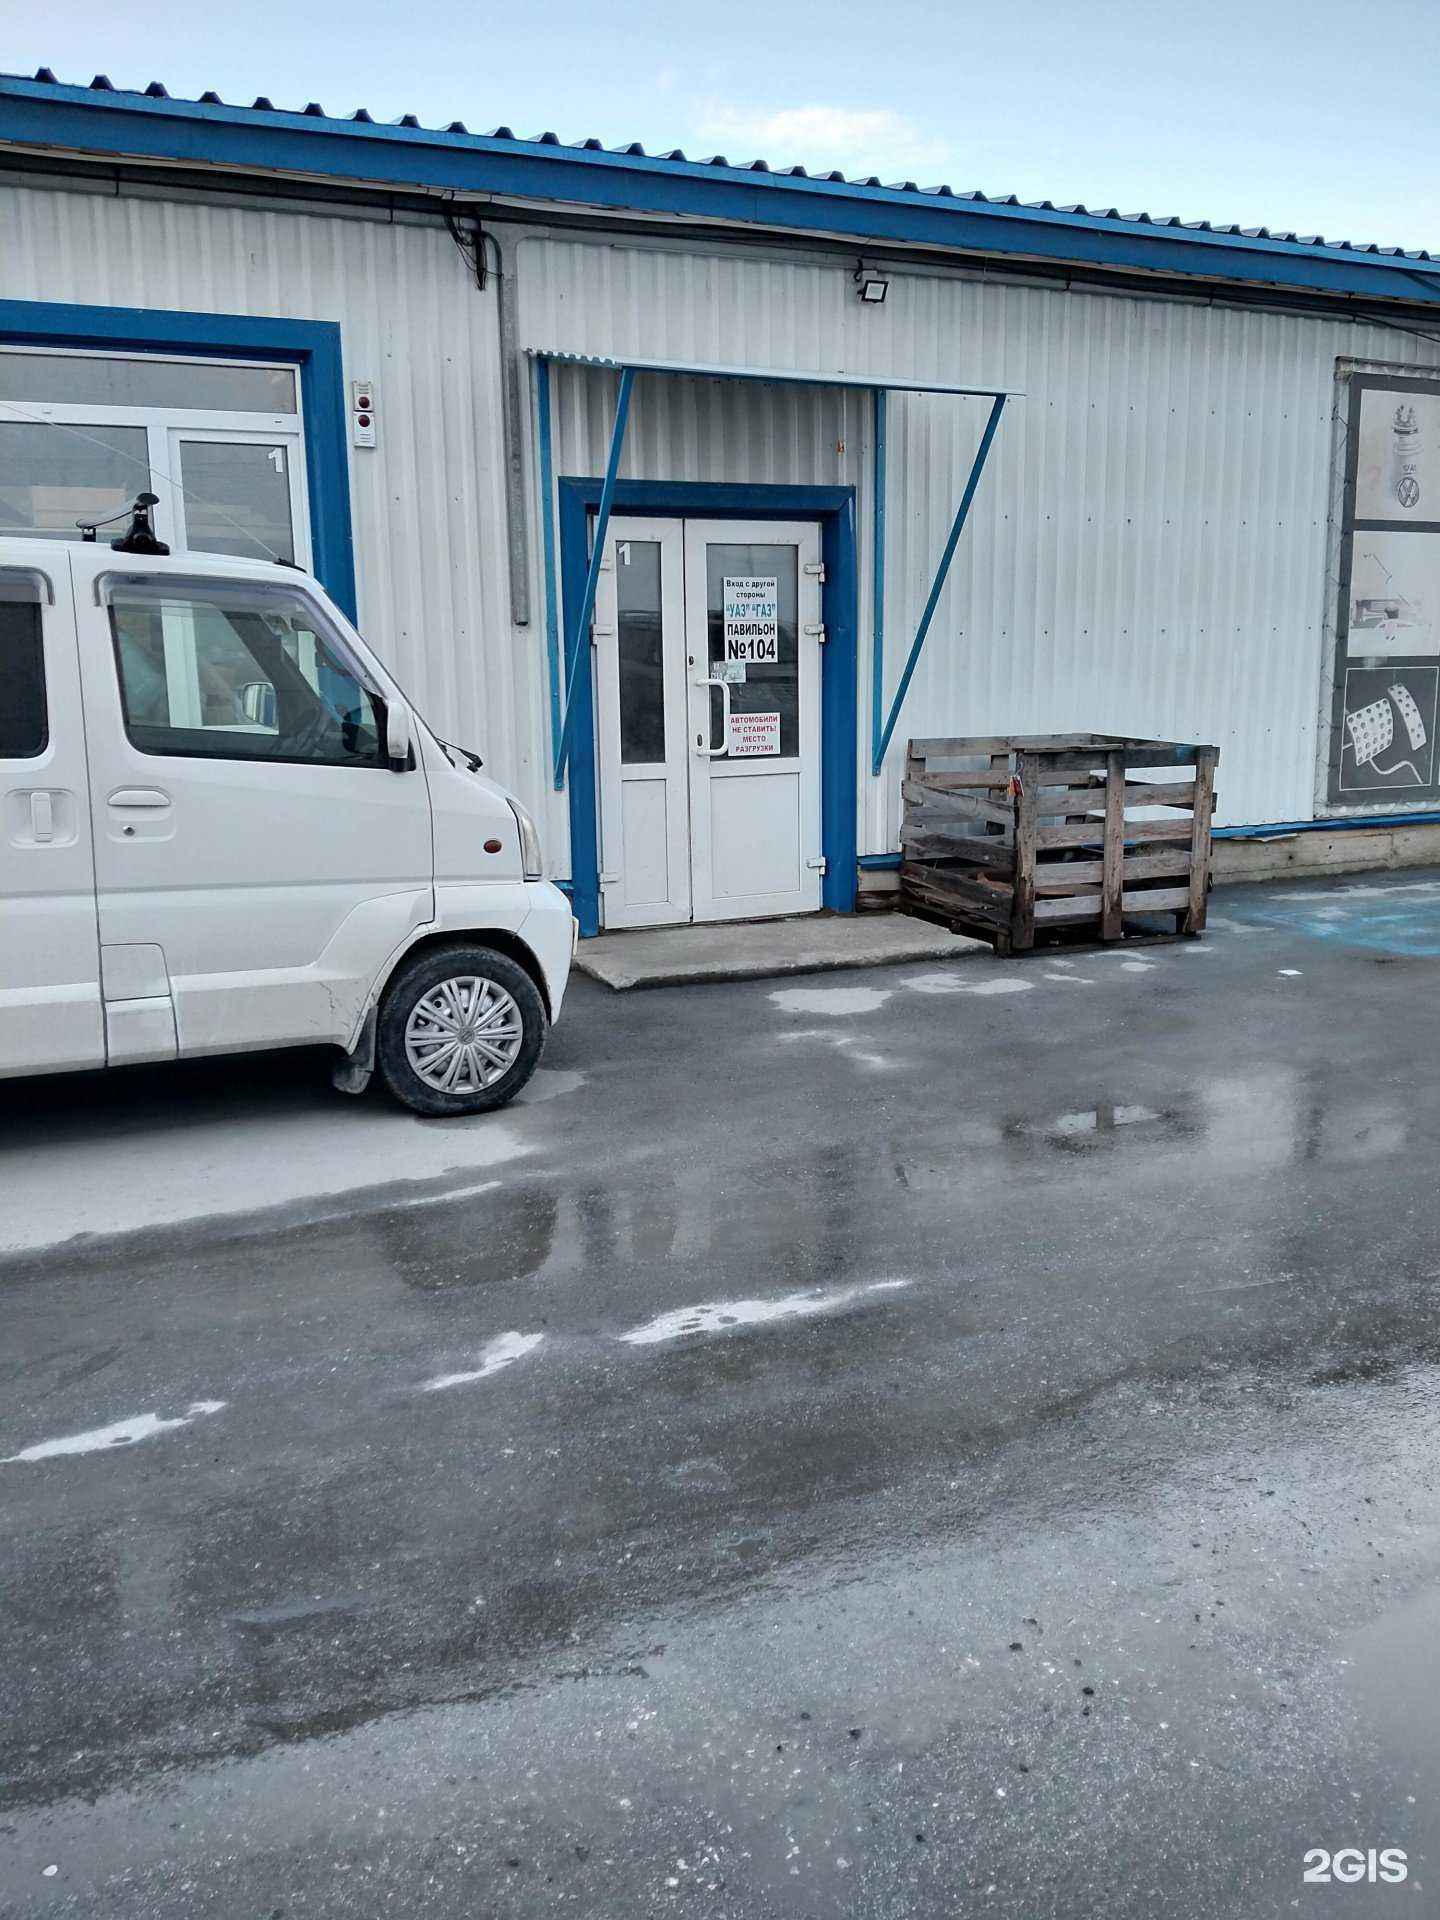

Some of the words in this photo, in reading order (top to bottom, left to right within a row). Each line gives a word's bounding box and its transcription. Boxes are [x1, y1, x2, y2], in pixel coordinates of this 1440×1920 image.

[268, 447, 284, 473] 1
[618, 542, 631, 566] 1
[726, 580, 744, 589] Вход
[751, 580, 775, 589] другой
[727, 623, 776, 636] ПАВИЛЬОН
[728, 638, 776, 660] №104
[730, 715, 778, 724] АВТОМОБИЛИ
[742, 735, 767, 743] МЕСТО
[735, 745, 774, 753] РАЗГРУЗКИ
